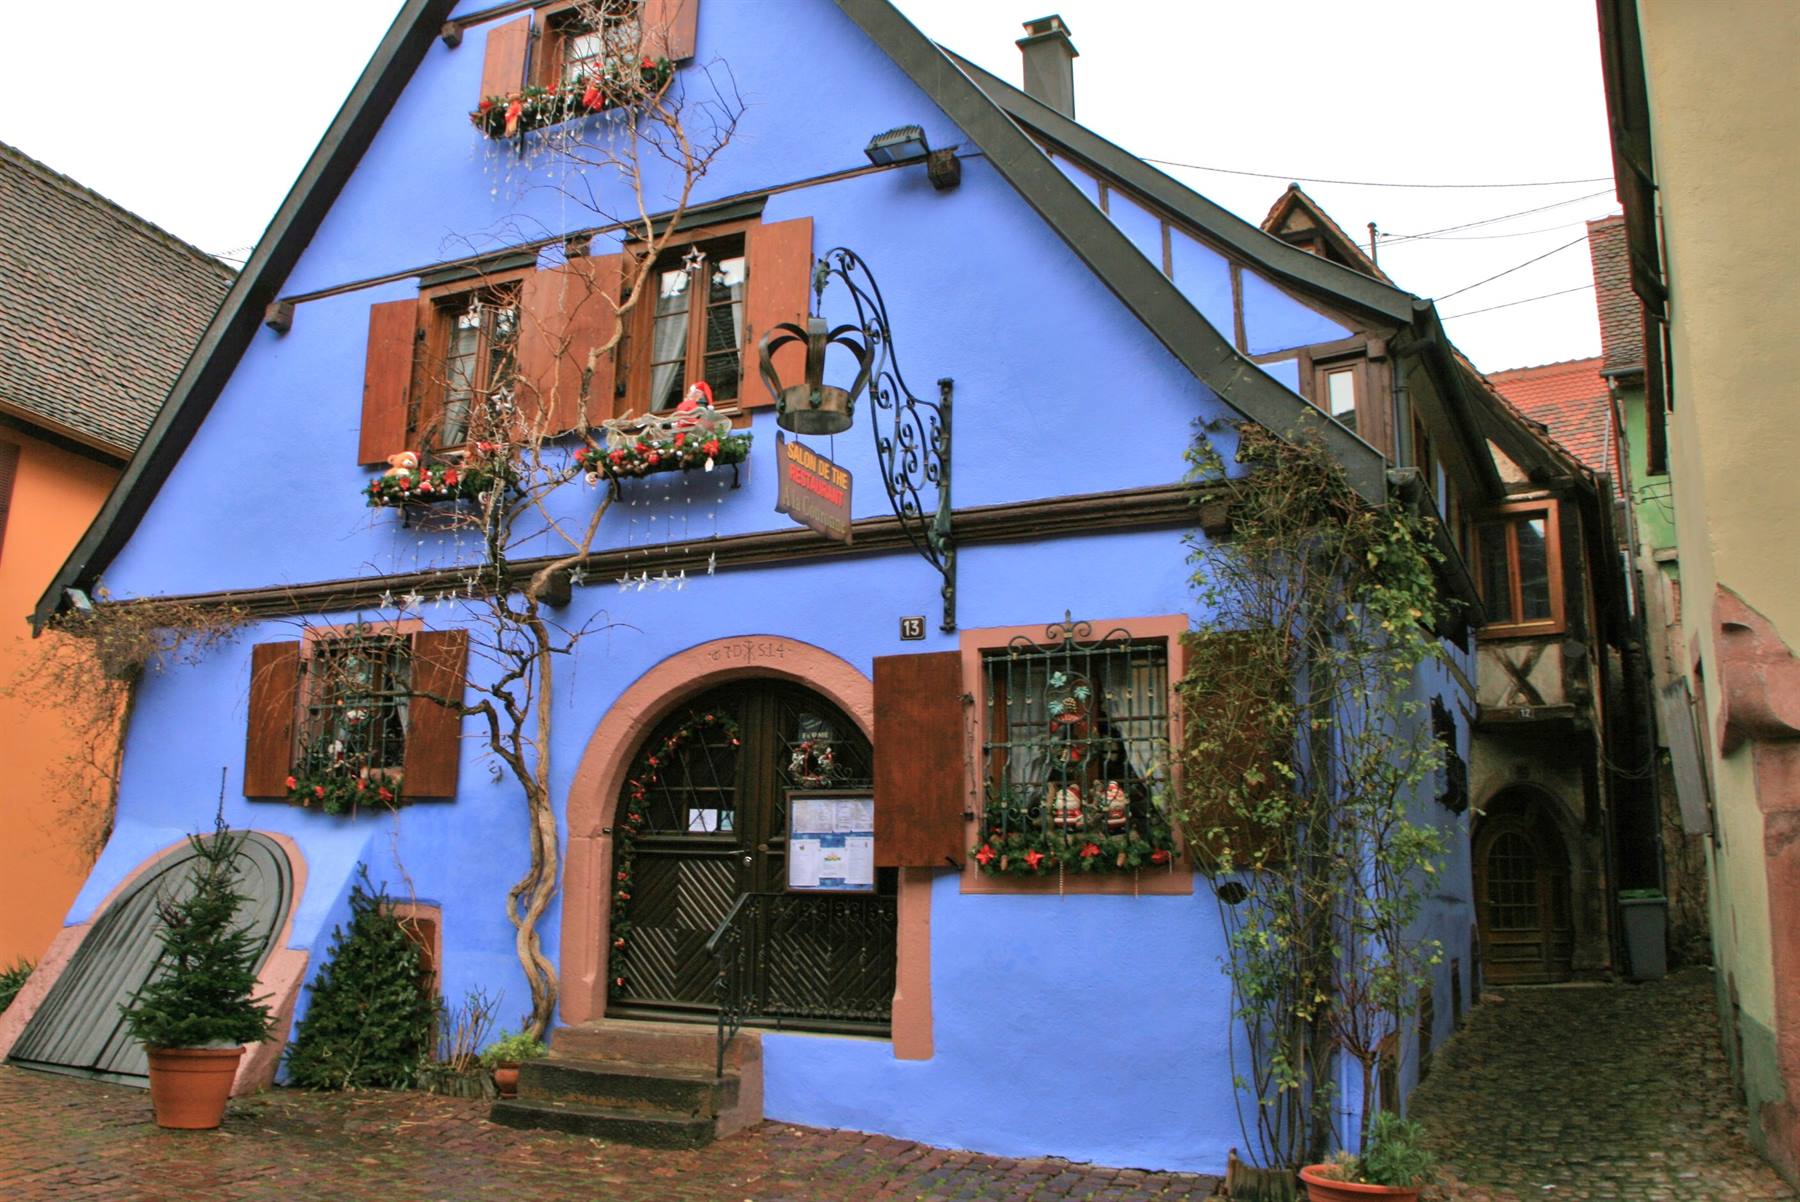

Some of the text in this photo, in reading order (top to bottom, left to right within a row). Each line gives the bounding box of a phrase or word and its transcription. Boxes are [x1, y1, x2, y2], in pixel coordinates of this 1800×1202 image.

[787, 442, 817, 473] SALON
[818, 459, 831, 480] DE
[789, 463, 845, 507] RESTAURANT
[903, 619, 920, 637] 13
